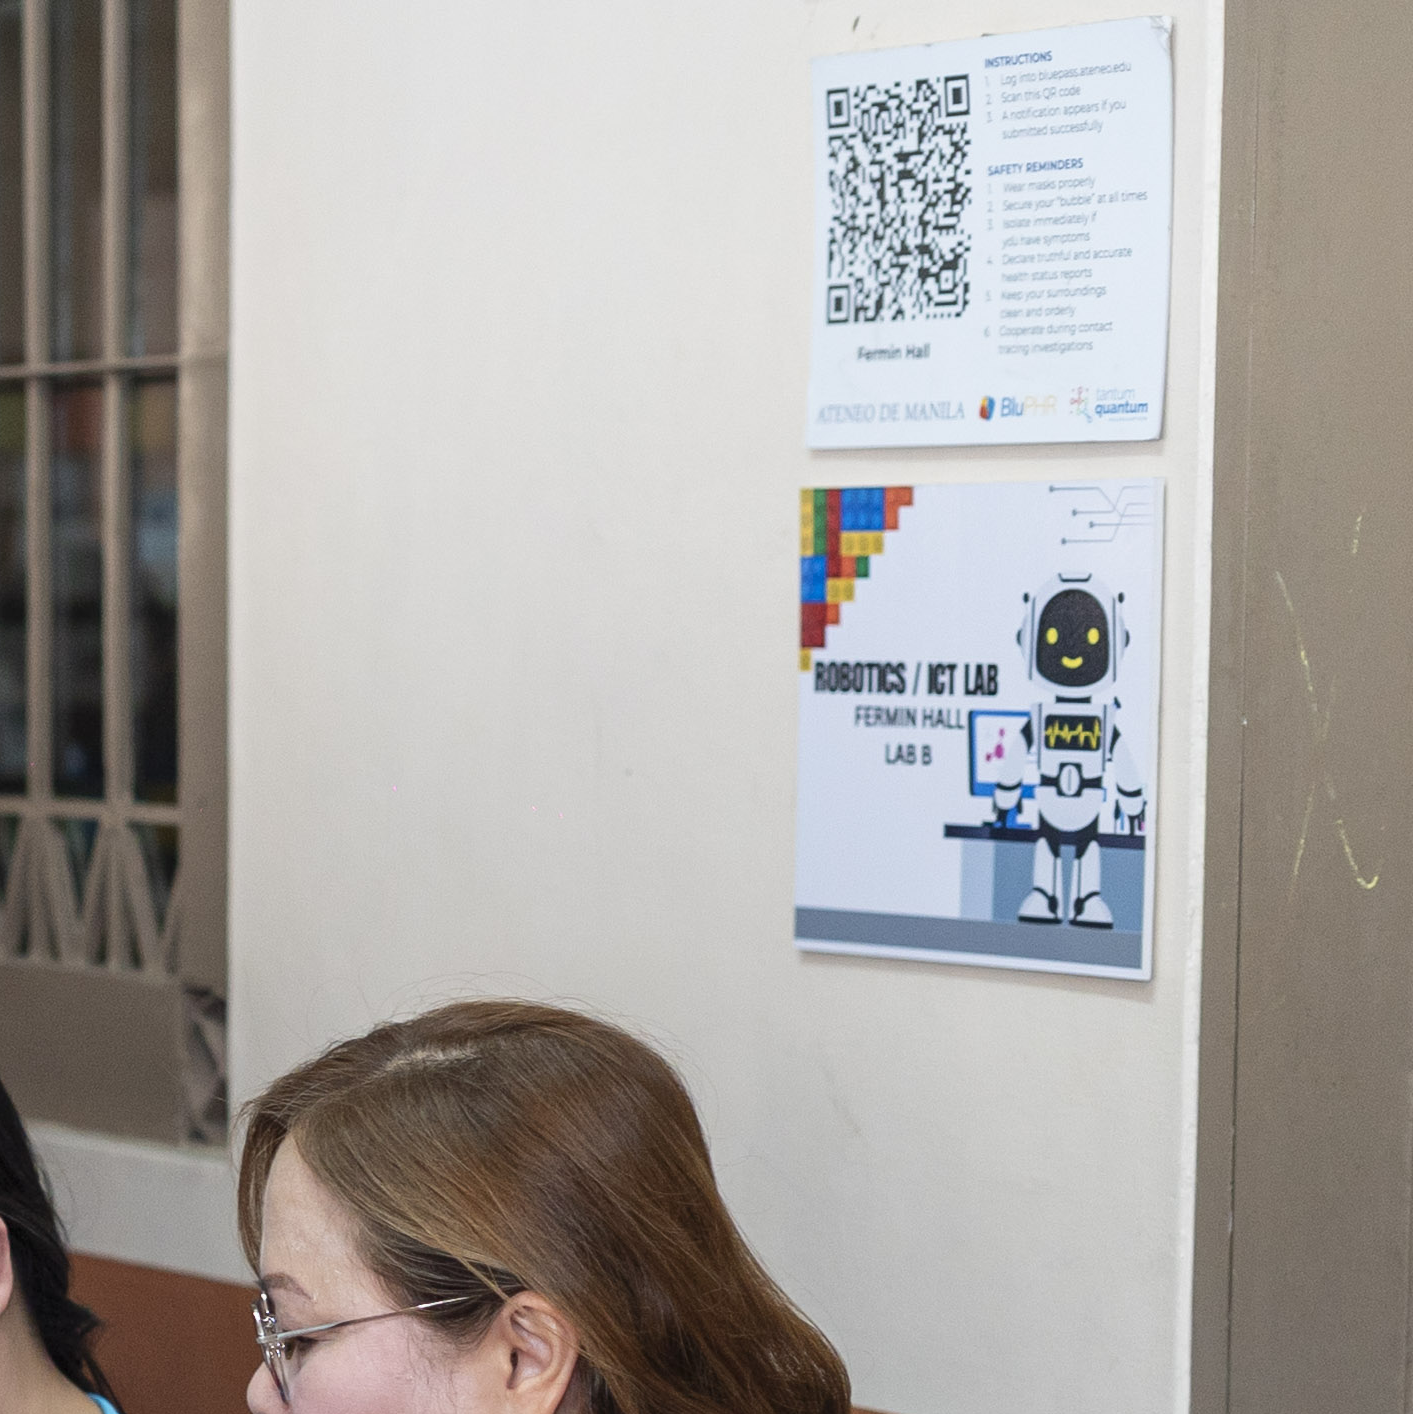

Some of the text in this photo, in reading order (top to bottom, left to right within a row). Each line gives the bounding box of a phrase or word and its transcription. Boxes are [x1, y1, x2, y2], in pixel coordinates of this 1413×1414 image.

[985, 50, 1053, 68] INSTRUCTIONS
[1001, 73, 1016, 86] Log
[1001, 92, 1022, 103] Scan
[1042, 87, 1056, 100] QR
[1059, 85, 1081, 97] code
[1010, 105, 1061, 119] notification
[1063, 101, 1099, 116] appears
[1109, 101, 1126, 113] you
[1002, 120, 1103, 139] submitted successfully
[988, 158, 1083, 176] SAFETY REMINDERS
[1058, 176, 1095, 191] properly
[1002, 199, 1033, 211] Secure
[1121, 190, 1148, 202] times
[1033, 212, 1088, 227] immediately
[1043, 232, 1090, 246] symptoms
[1001, 252, 1035, 265] Declare
[1073, 249, 1091, 260] and
[1093, 247, 1133, 259] accurate
[1046, 285, 1107, 299] surroundings
[999, 325, 1045, 338] Cooperate
[1046, 322, 1076, 336] during
[1078, 321, 1113, 332] contact
[857, 342, 931, 361] Fermin Hall
[1032, 340, 1093, 354] investigations
[816, 401, 965, 424] ATENEO DE MANILA
[1095, 402, 1148, 418] quantum
[814, 661, 907, 694] ROBOTICS
[928, 663, 957, 696] ICT
[964, 663, 999, 696] LAB
[854, 705, 965, 730] FERMIN HALL
[885, 743, 932, 766] LAB B
